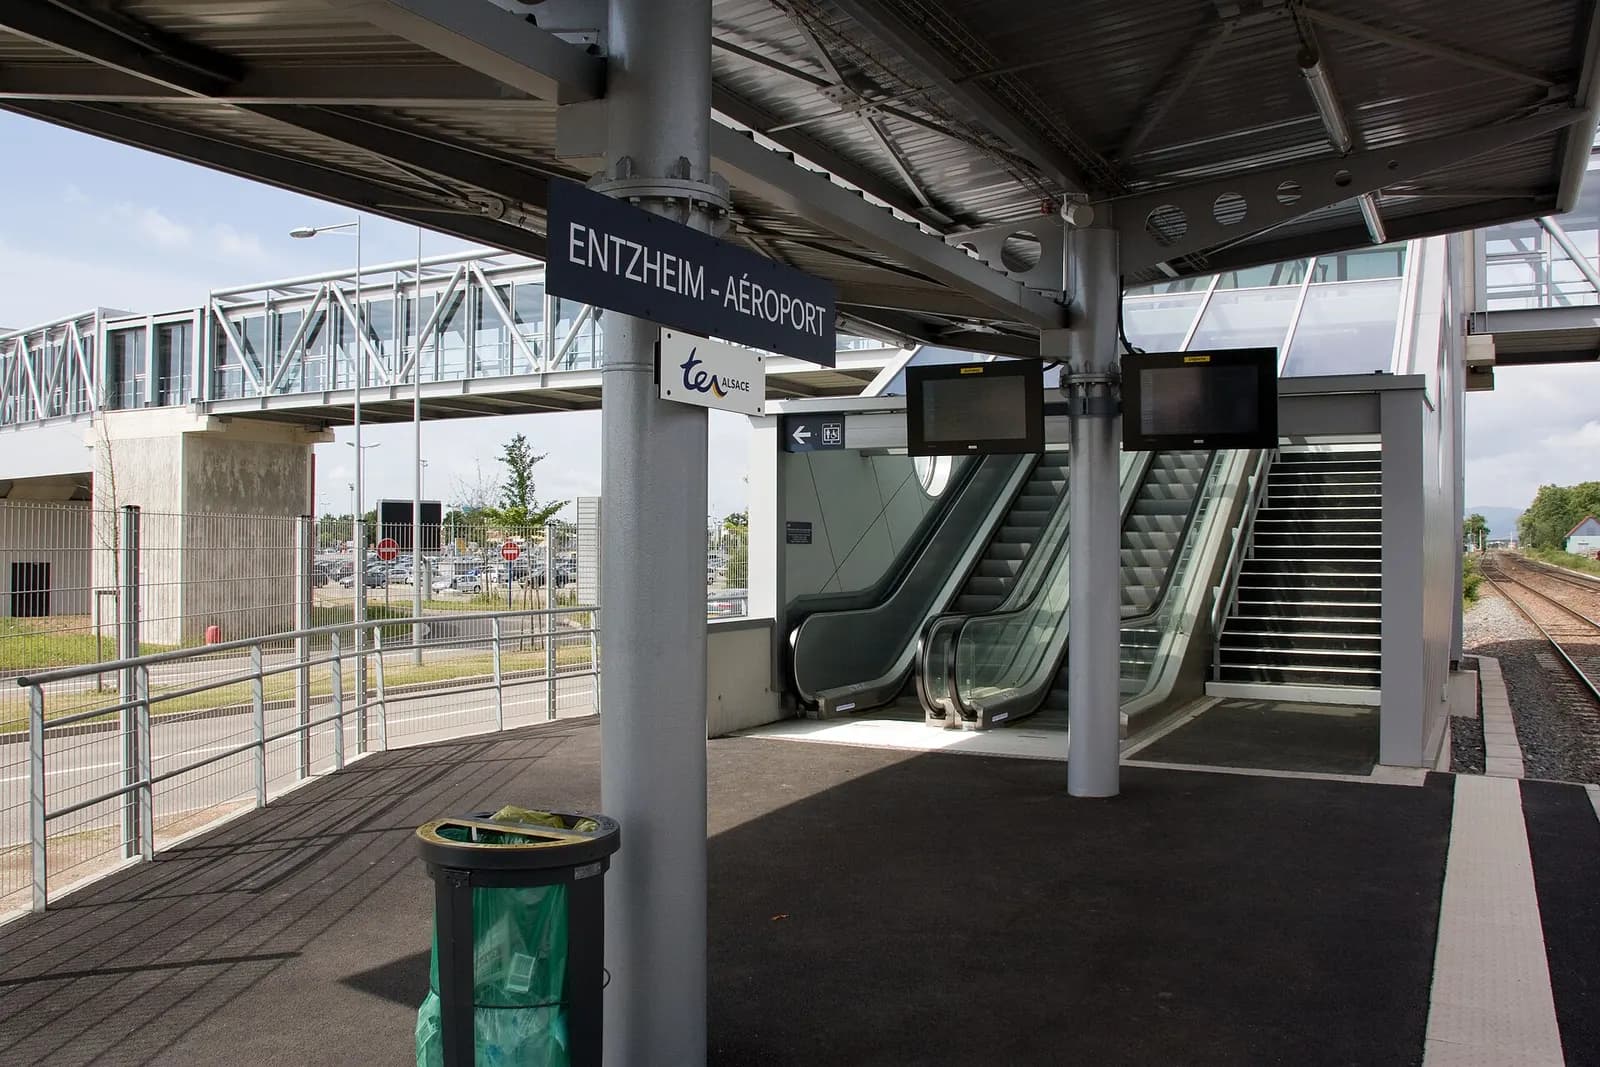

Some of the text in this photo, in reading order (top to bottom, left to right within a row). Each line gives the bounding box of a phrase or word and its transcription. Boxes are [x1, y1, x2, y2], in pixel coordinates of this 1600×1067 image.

[569, 222, 705, 301] ENTZHEIM
[723, 273, 826, 337] AÉROPORT
[680, 347, 750, 399] ter ALSACE
